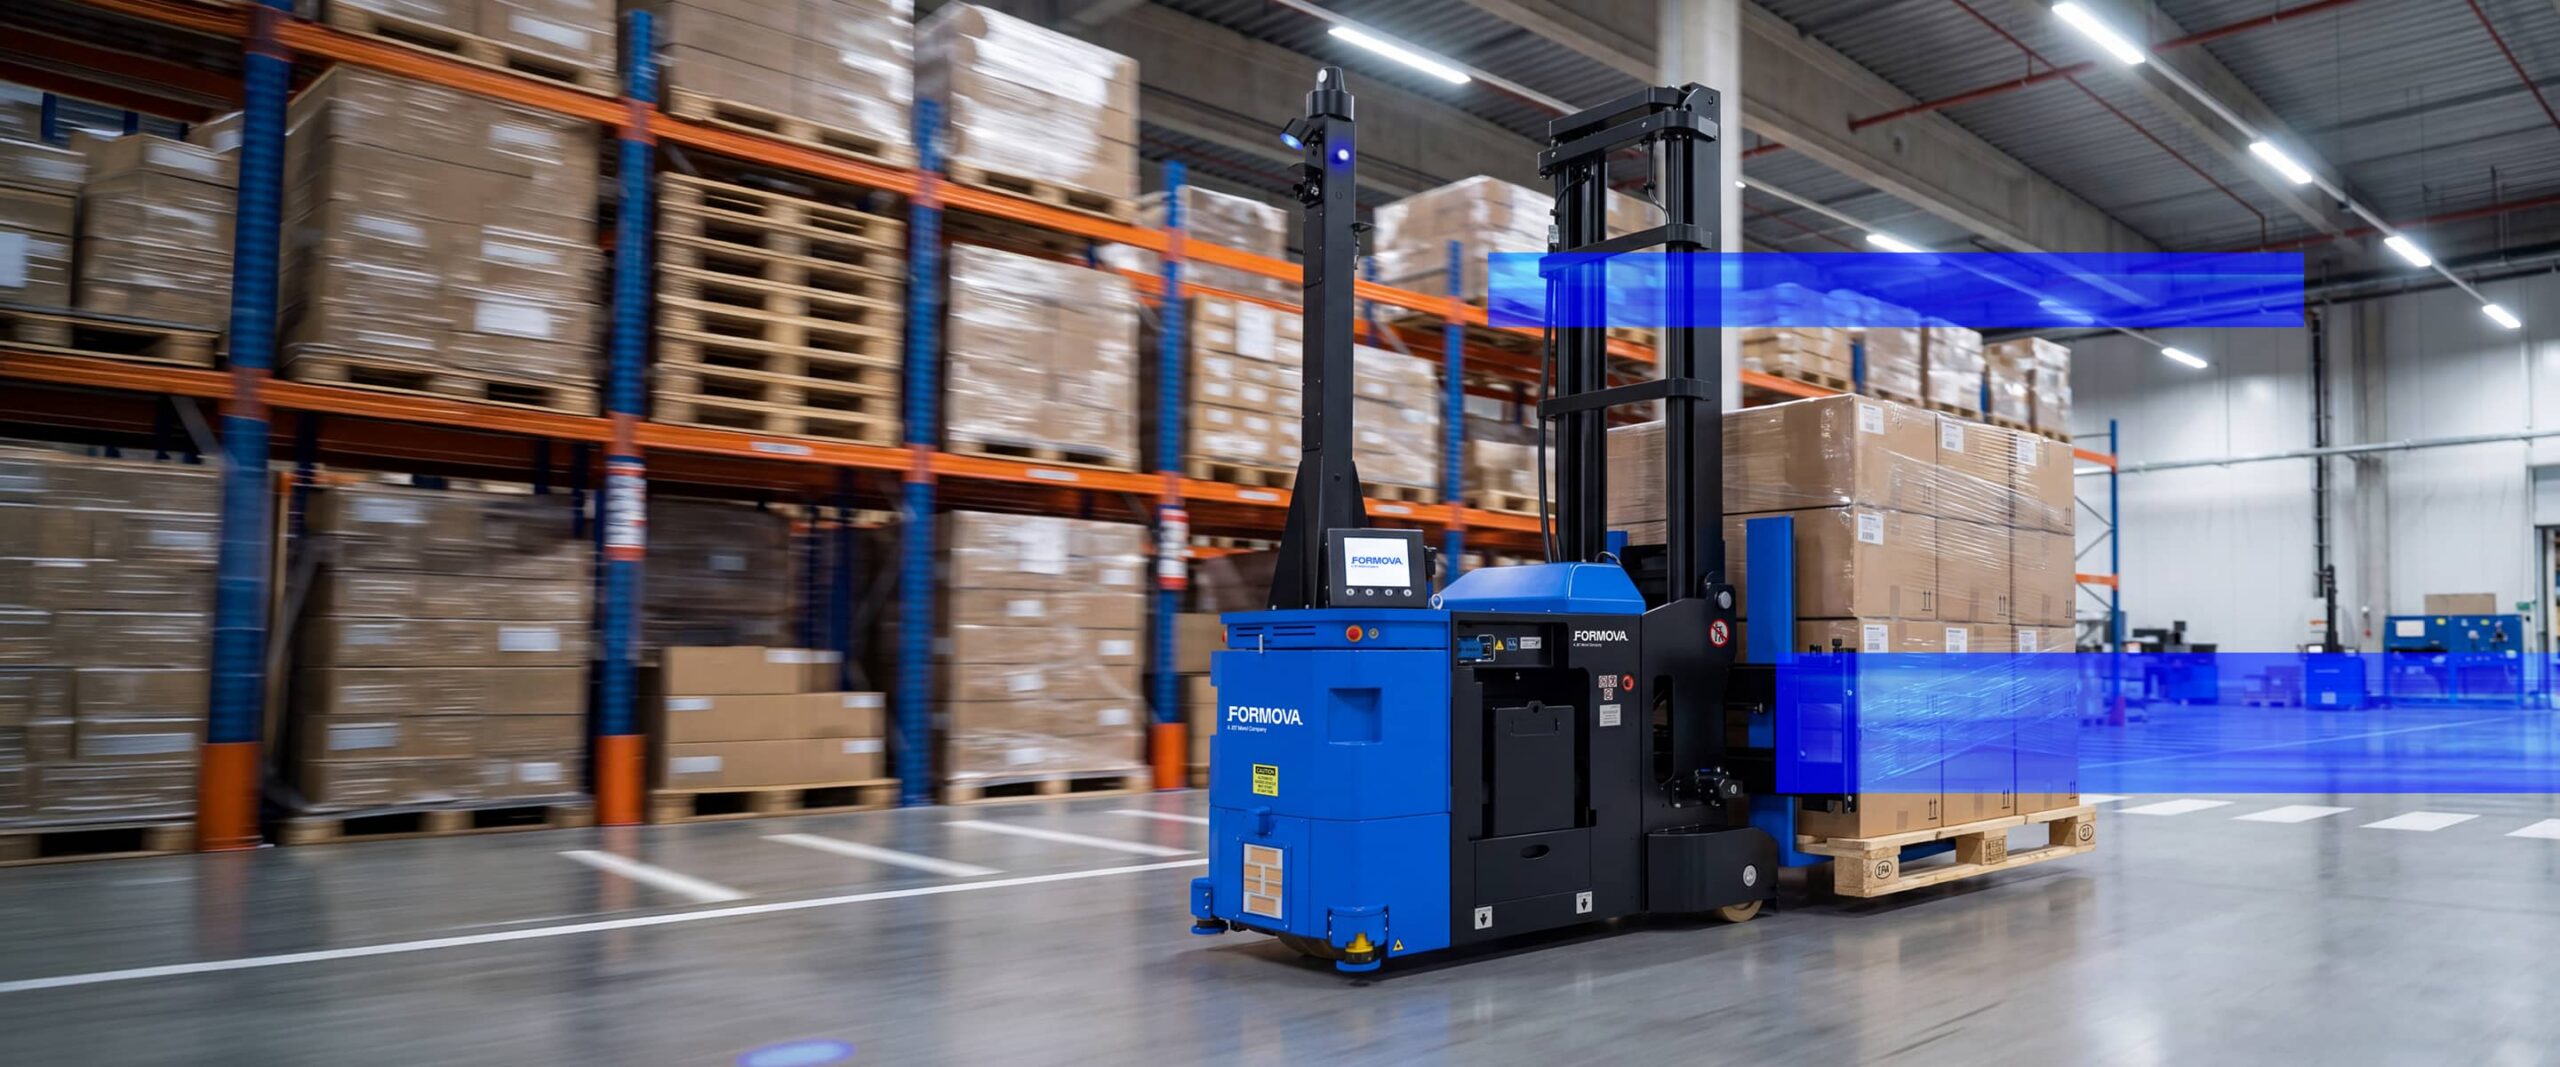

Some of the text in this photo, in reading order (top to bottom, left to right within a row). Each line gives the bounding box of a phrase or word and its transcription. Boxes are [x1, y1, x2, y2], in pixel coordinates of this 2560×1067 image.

[1351, 556, 1404, 565] FORMOVA
[1573, 630, 1629, 641] FORMOVA
[1227, 705, 1304, 725] FORMOVA
